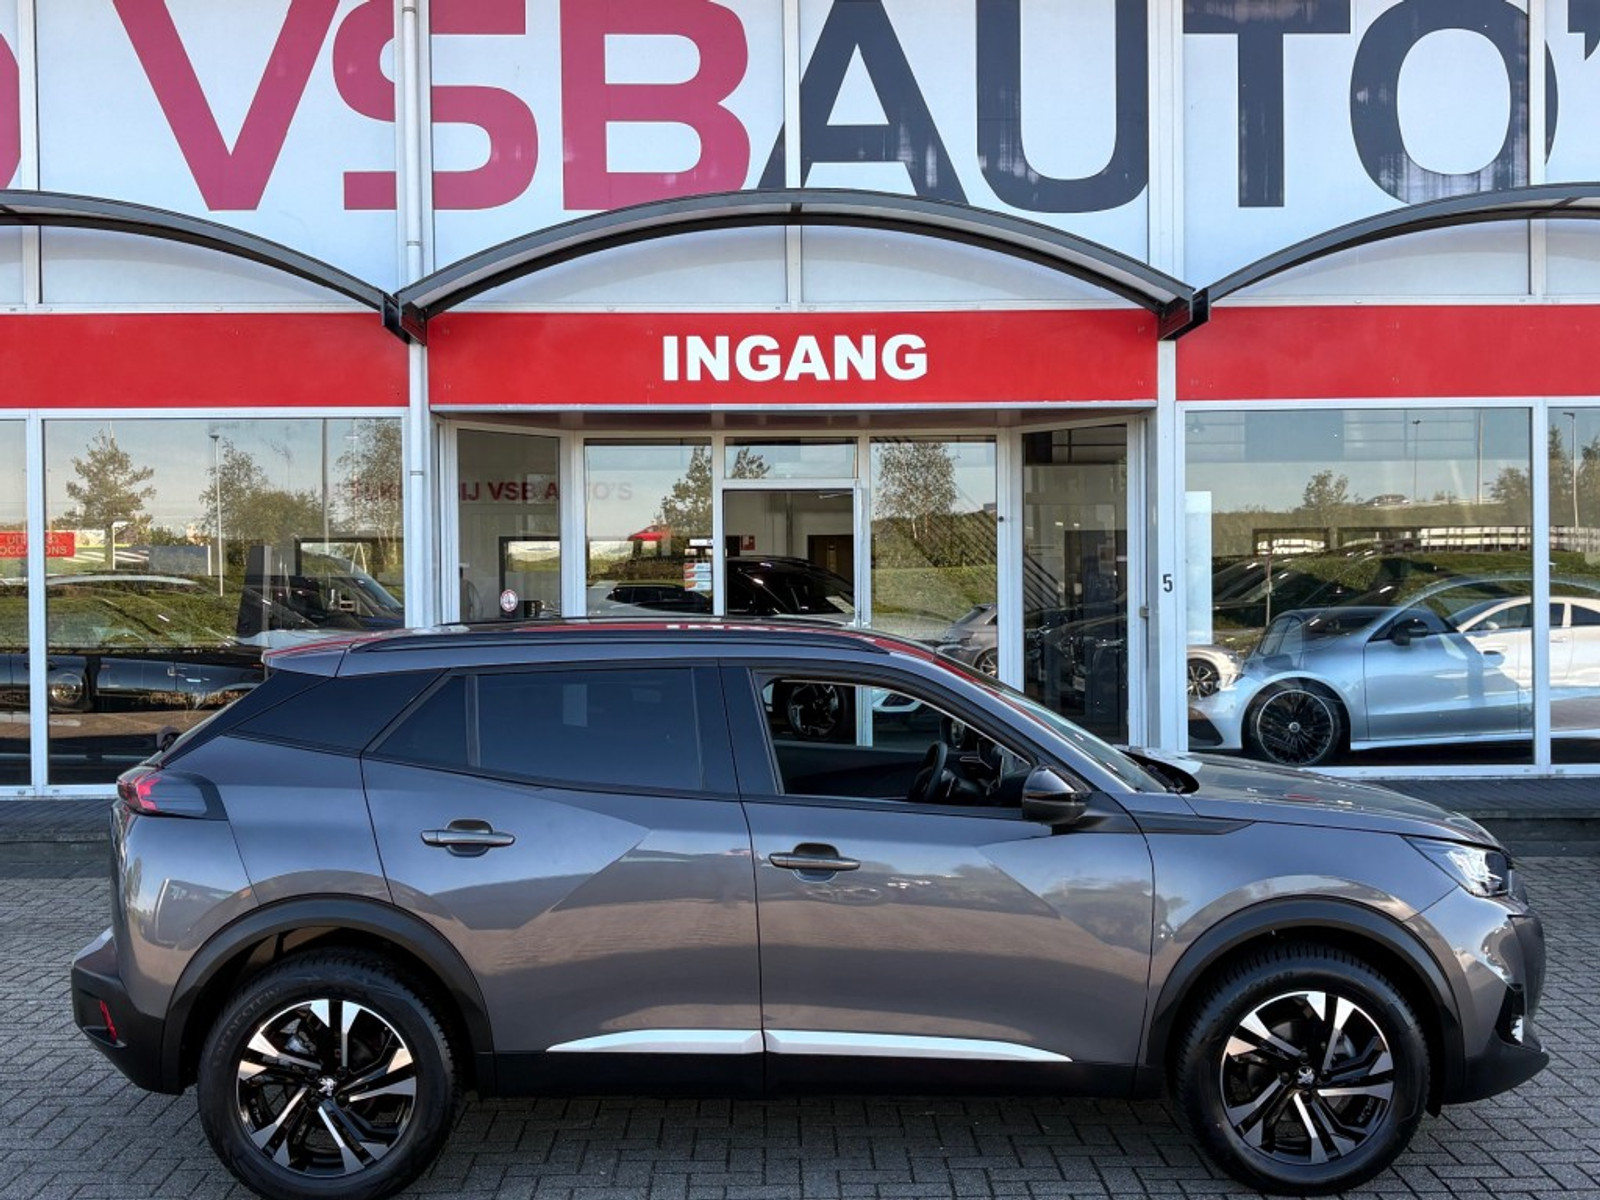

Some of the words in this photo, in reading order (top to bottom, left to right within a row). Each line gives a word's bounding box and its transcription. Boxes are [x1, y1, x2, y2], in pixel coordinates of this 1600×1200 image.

[663, 334, 928, 382] INGANG
[488, 482, 535, 500] VSB
[1163, 573, 1173, 593] 5
